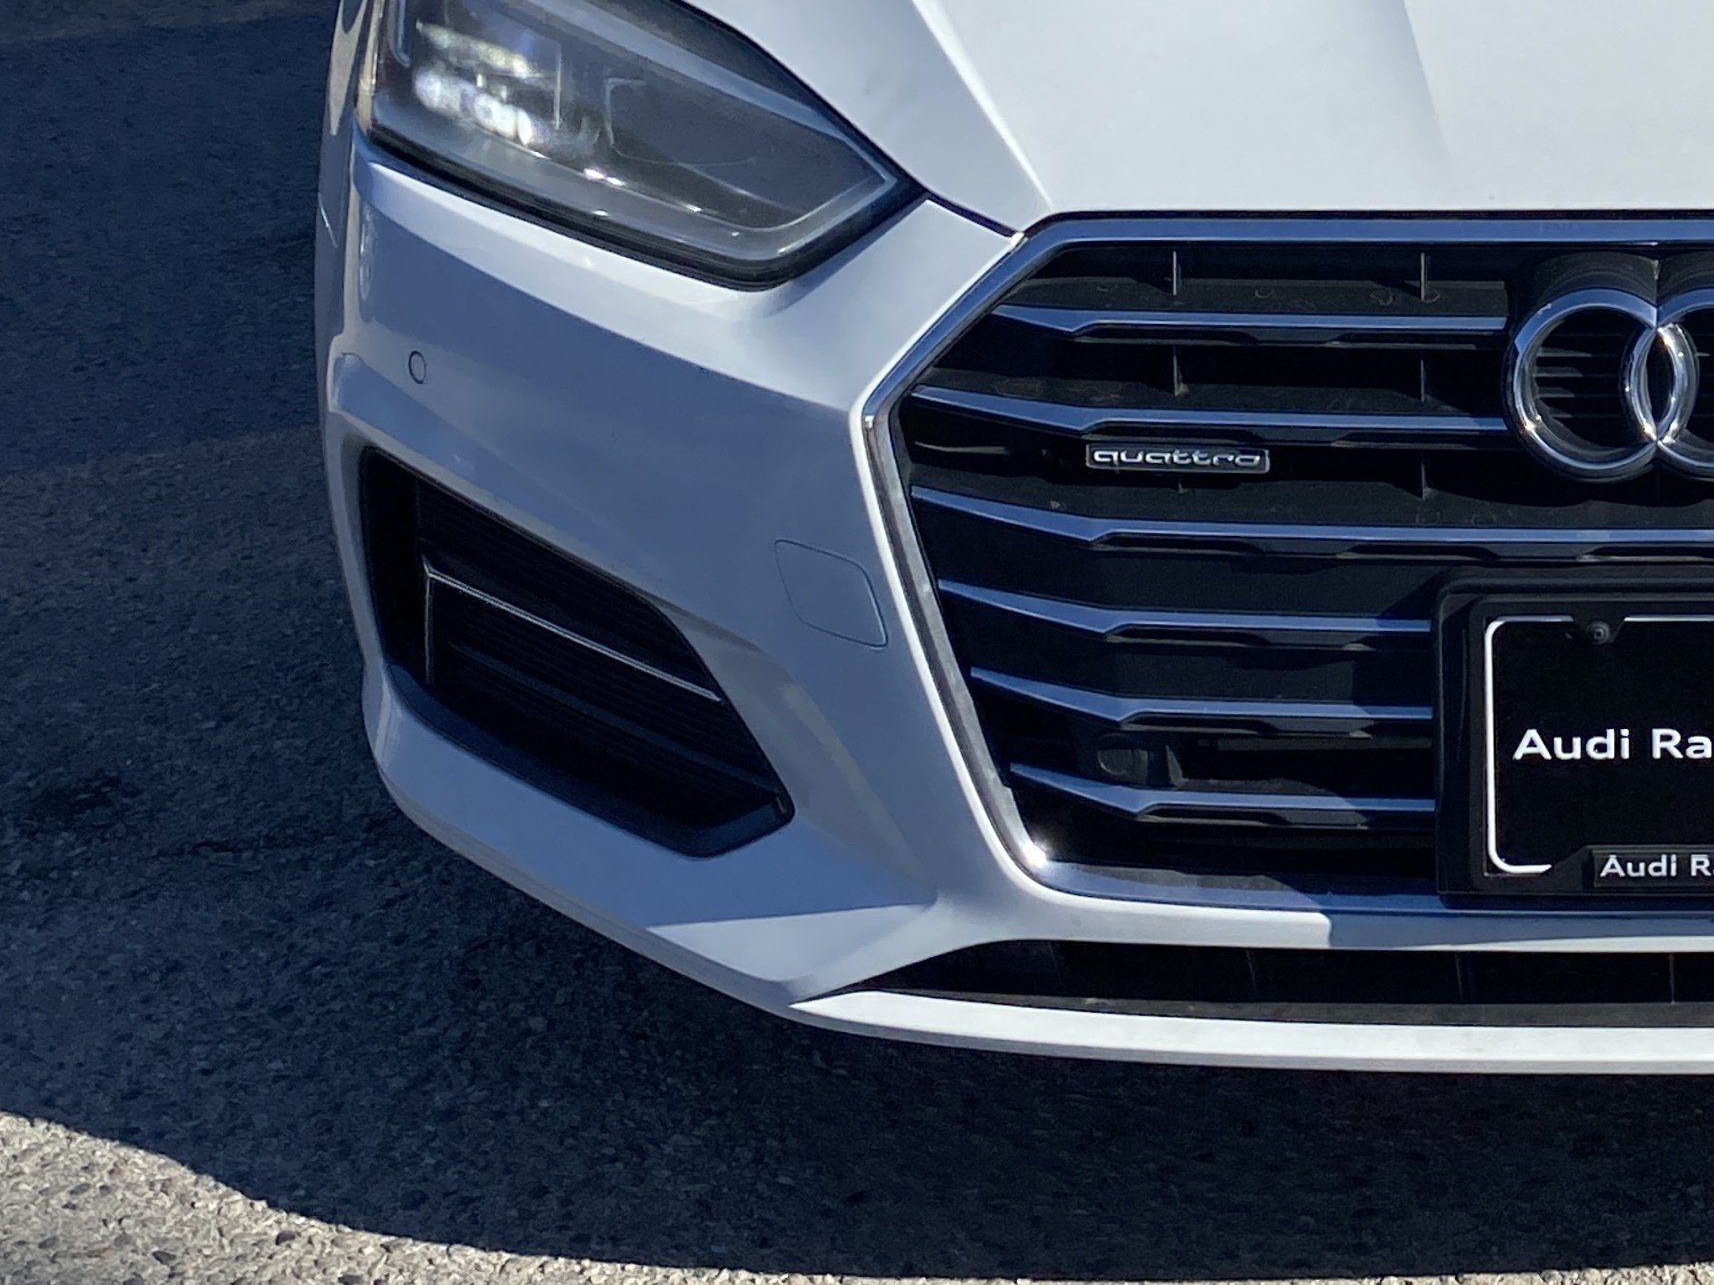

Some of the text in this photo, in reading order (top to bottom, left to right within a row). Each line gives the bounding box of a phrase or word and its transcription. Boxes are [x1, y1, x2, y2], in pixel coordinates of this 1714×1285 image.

[1093, 449, 1260, 471] quattro
[1512, 728, 1630, 761] Audi
[1600, 854, 1678, 879] Audi
